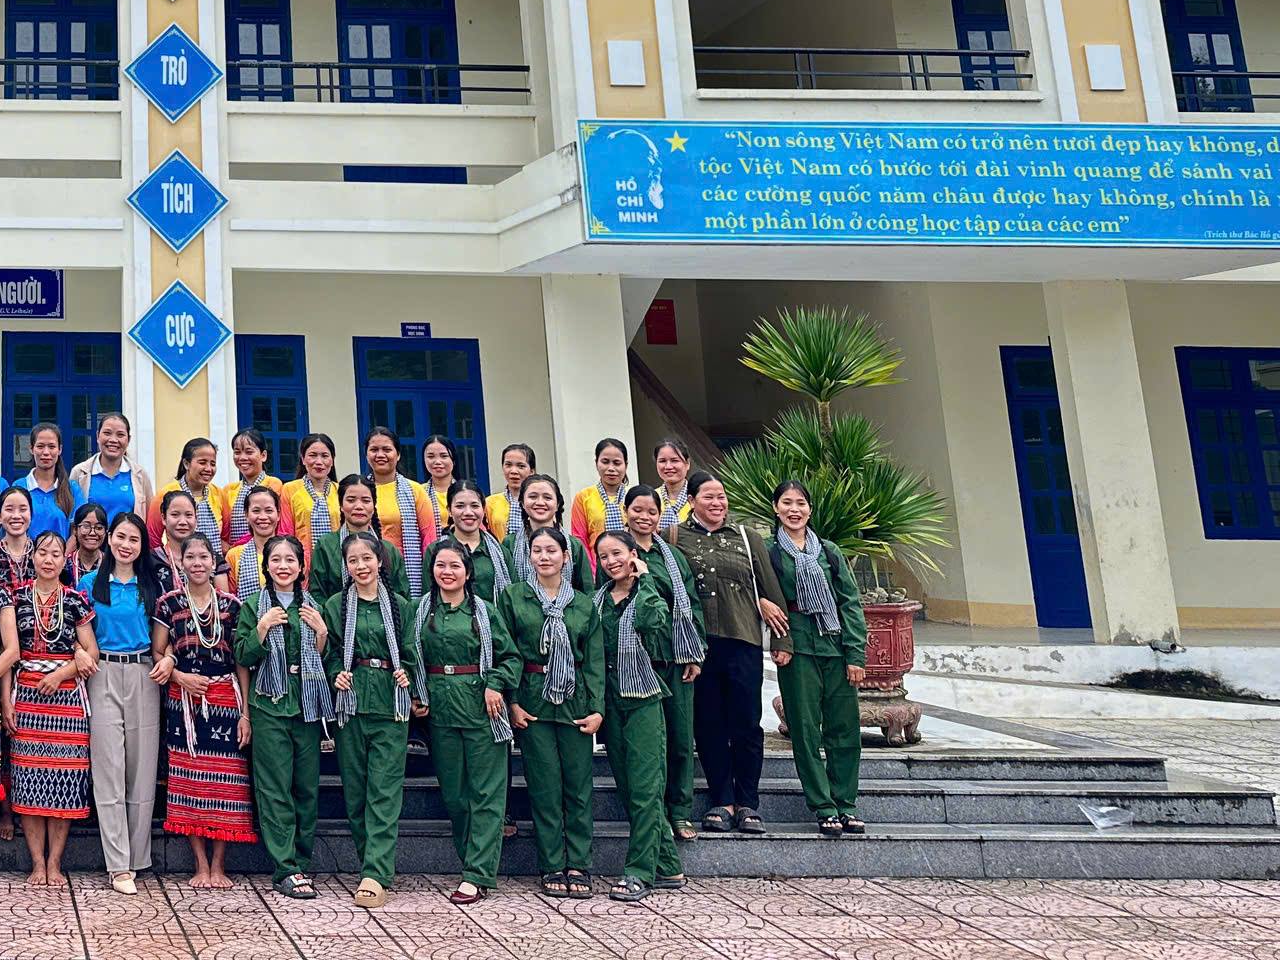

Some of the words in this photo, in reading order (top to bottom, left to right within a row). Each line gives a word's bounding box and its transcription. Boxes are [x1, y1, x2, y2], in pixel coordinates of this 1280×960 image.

[160, 49, 187, 86] TRÒ
[724, 130, 781, 148] “Non
[786, 131, 836, 152] sông
[839, 132, 884, 153] Việt
[888, 132, 939, 149] Nam
[943, 133, 967, 150] có
[970, 132, 1004, 150] trở
[1008, 134, 1049, 150] nên
[1053, 134, 1096, 151] tươi
[1101, 134, 1141, 156] đẹp
[1144, 135, 1184, 155] hay
[1187, 135, 1263, 157] không,
[699, 157, 733, 178] tộc
[737, 157, 784, 179] Việt
[789, 158, 842, 175] Nam
[848, 160, 873, 176] có
[879, 159, 933, 176] bước
[938, 160, 968, 176] tới
[975, 160, 1010, 177] đài
[1016, 160, 1067, 177] vinh
[1073, 165, 1142, 182] quang
[1148, 158, 1175, 178] để
[1181, 162, 1234, 179] sánh
[1238, 163, 1273, 180] vai
[161, 176, 193, 214] TÍCH
[616, 193, 643, 207] CHÍ
[702, 185, 738, 201] các
[818, 184, 872, 206] quốc
[878, 187, 927, 203] năm
[932, 187, 986, 204] châu
[992, 187, 1046, 209] được
[1052, 187, 1093, 208] hay
[1098, 188, 1175, 210] không,
[1181, 189, 1245, 207] chính
[1248, 189, 1272, 207] là
[618, 211, 658, 223] MINH
[704, 211, 747, 233] một
[751, 209, 808, 233] phần
[810, 212, 846, 230] lớn
[849, 211, 863, 230] ở
[866, 213, 918, 235] công
[921, 213, 961, 236] học
[963, 214, 1001, 236] tập
[1004, 212, 1043, 232] của
[1047, 215, 1084, 232] các
[1087, 215, 1130, 233] em”
[165, 312, 195, 354] CỰC
